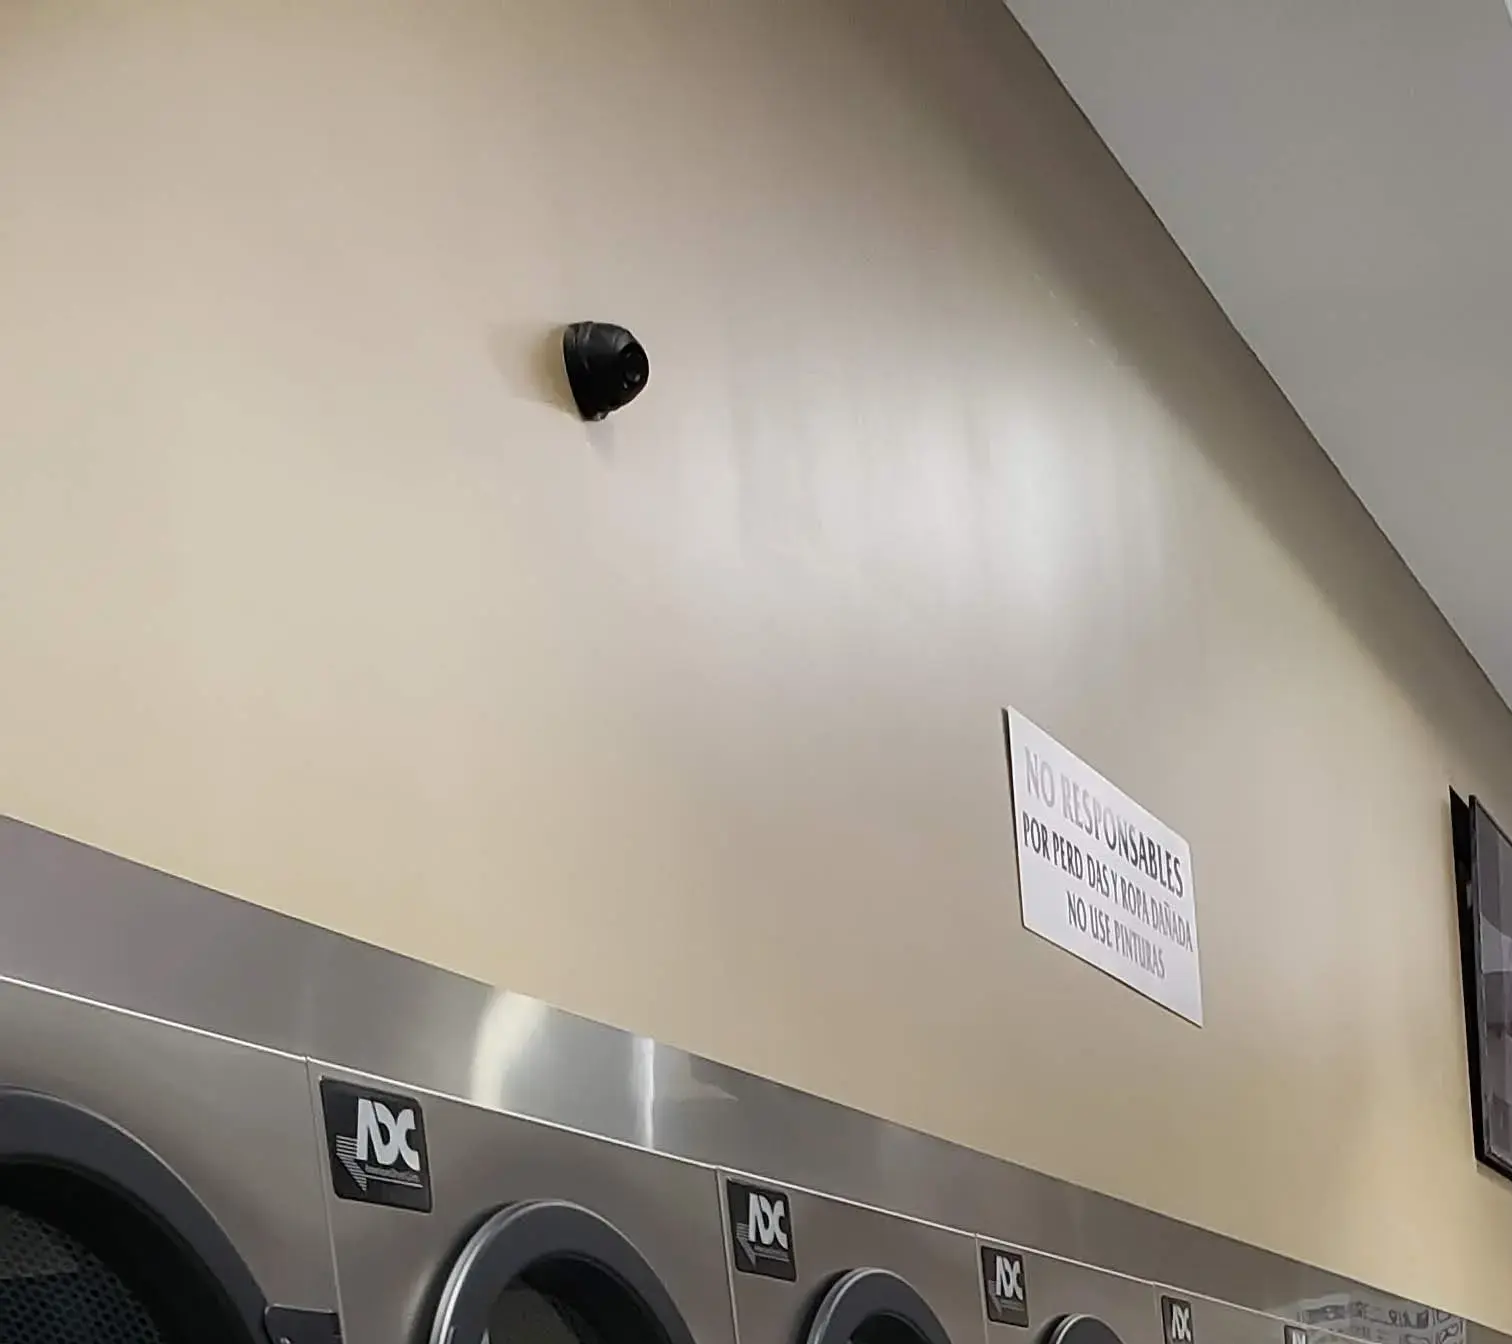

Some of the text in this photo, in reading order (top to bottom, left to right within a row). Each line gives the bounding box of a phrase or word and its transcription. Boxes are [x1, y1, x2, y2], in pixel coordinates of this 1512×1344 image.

[1025, 746, 1184, 898] NO RESPONSABLES
[1022, 810, 1051, 861] POR
[1111, 869, 1118, 904] Y
[1120, 876, 1150, 925] ROPA
[1151, 897, 1193, 953] DAÑADA
[1067, 890, 1165, 979] NO USE PINTURAS
[356, 1098, 421, 1172] ADC
[748, 1193, 789, 1250] ADC
[995, 1255, 1024, 1301] ADC
